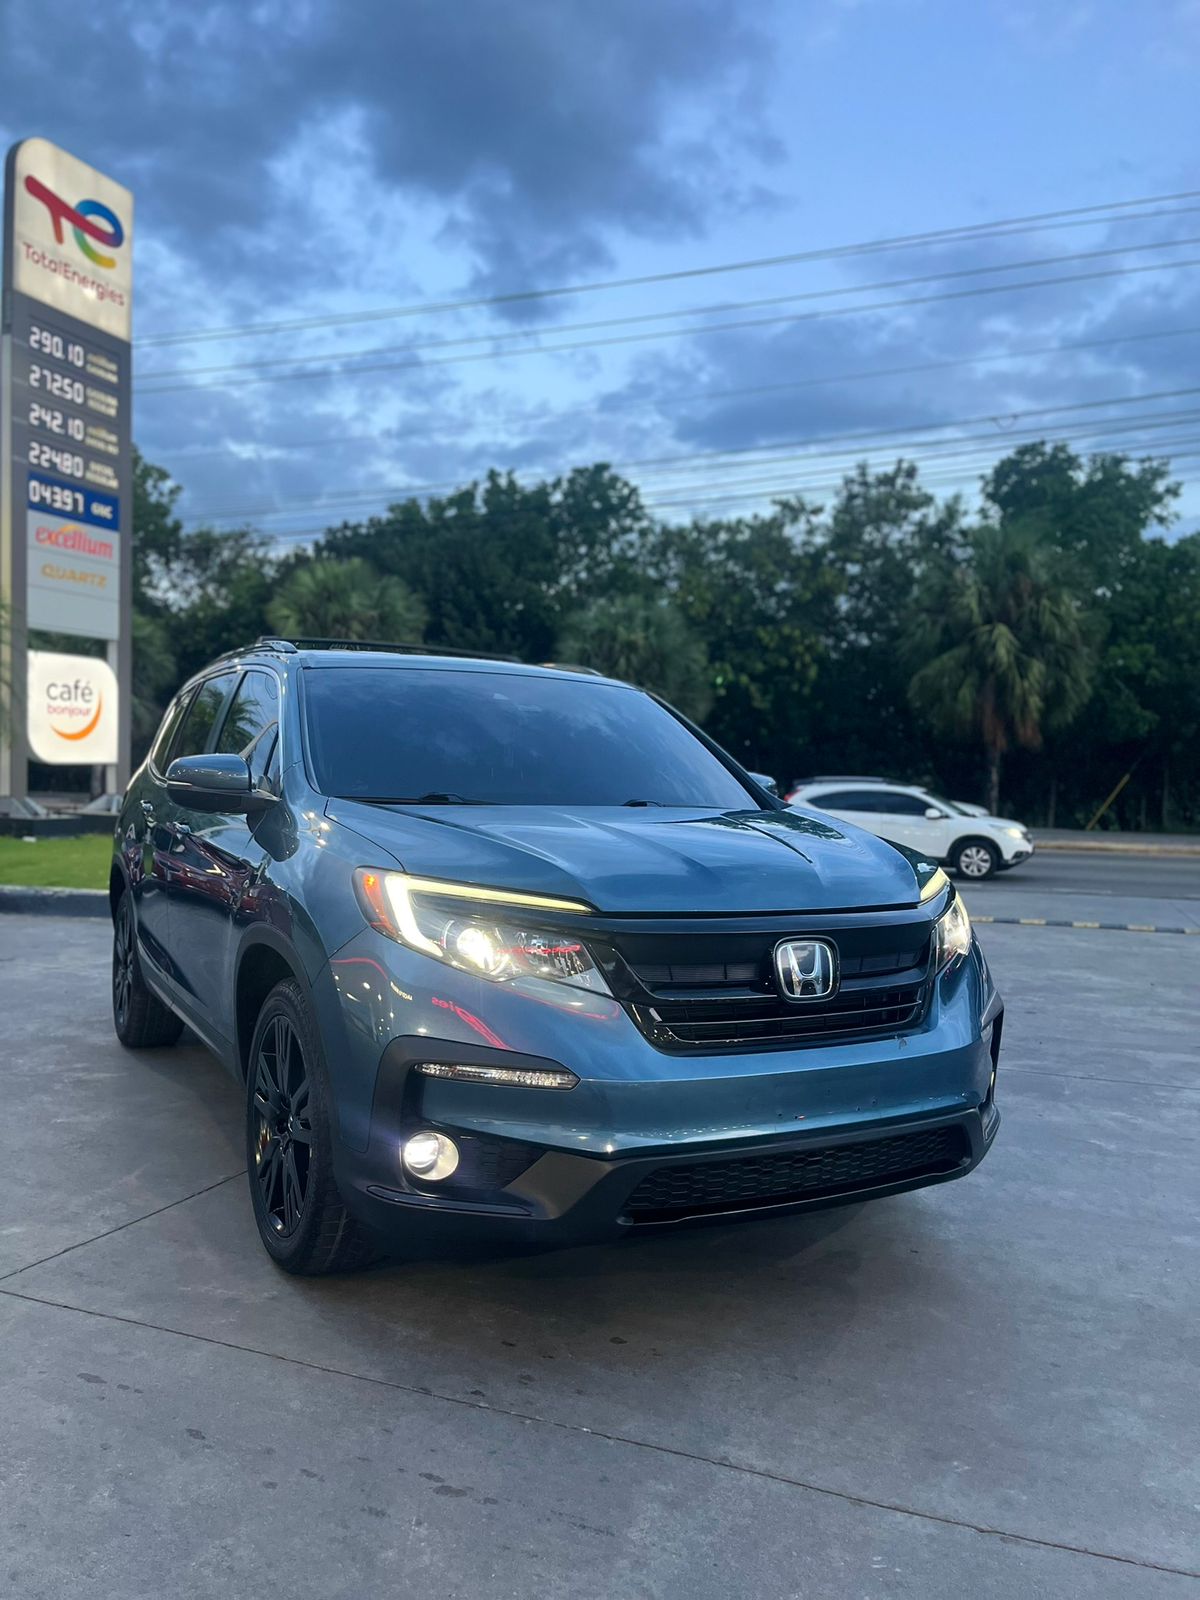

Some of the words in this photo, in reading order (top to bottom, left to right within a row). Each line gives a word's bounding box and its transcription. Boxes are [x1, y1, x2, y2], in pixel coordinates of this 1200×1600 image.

[23, 241, 125, 306] TotalEnergies
[46, 679, 93, 703] café
[47, 703, 92, 718] bonjour
